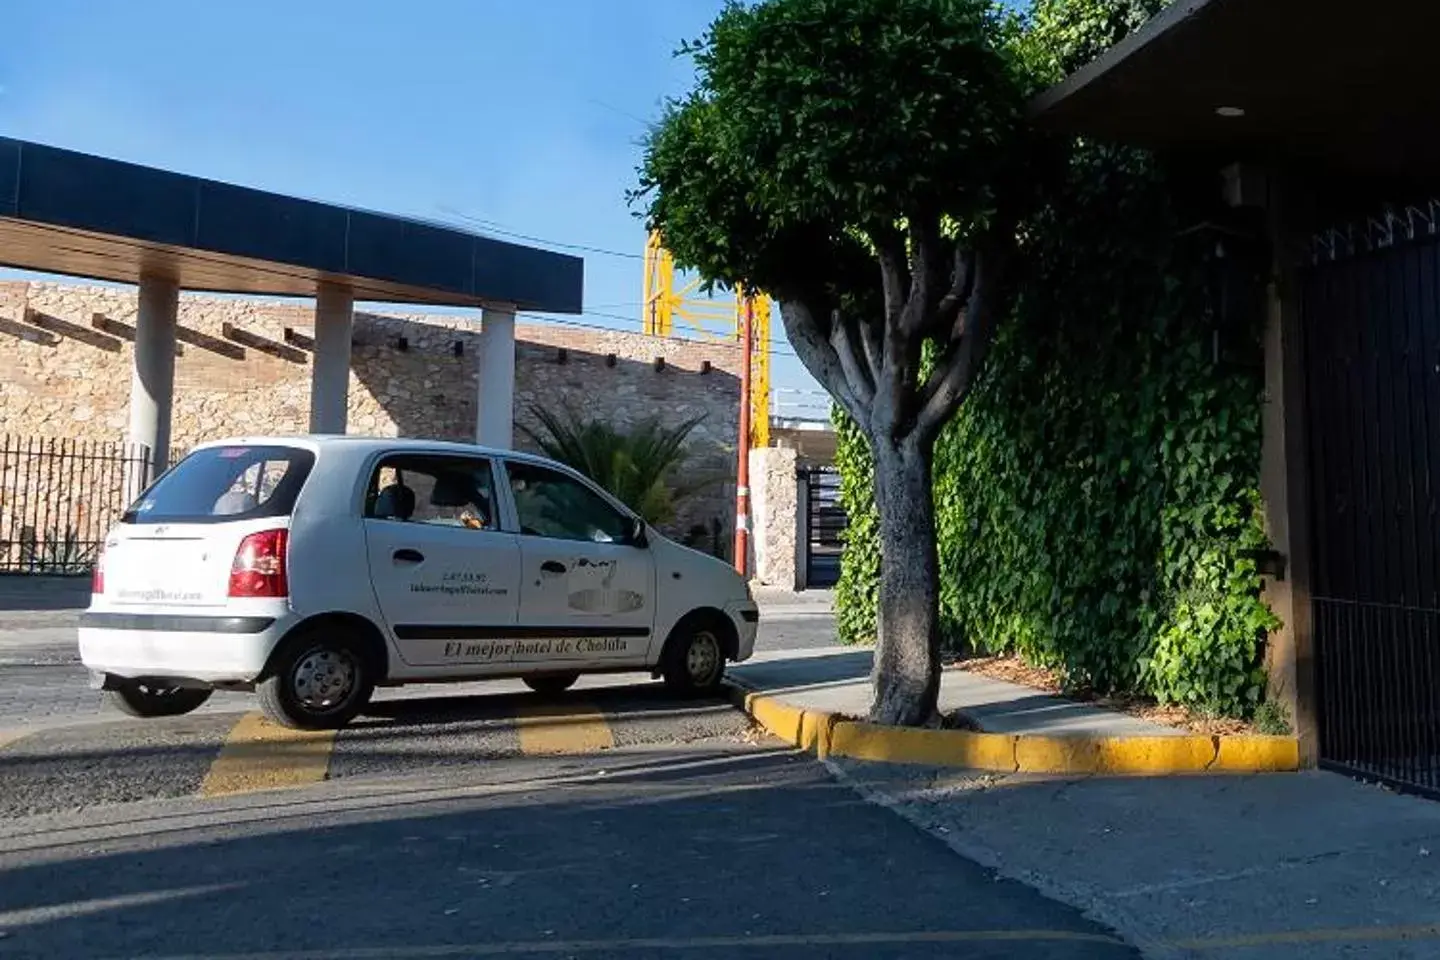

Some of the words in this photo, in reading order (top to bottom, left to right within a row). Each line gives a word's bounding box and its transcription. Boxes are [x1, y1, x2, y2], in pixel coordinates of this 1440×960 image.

[444, 642, 462, 656] El
[464, 641, 512, 659] mejor
[515, 640, 551, 654] hotel
[555, 639, 572, 653] de
[575, 637, 627, 653] Cholula
